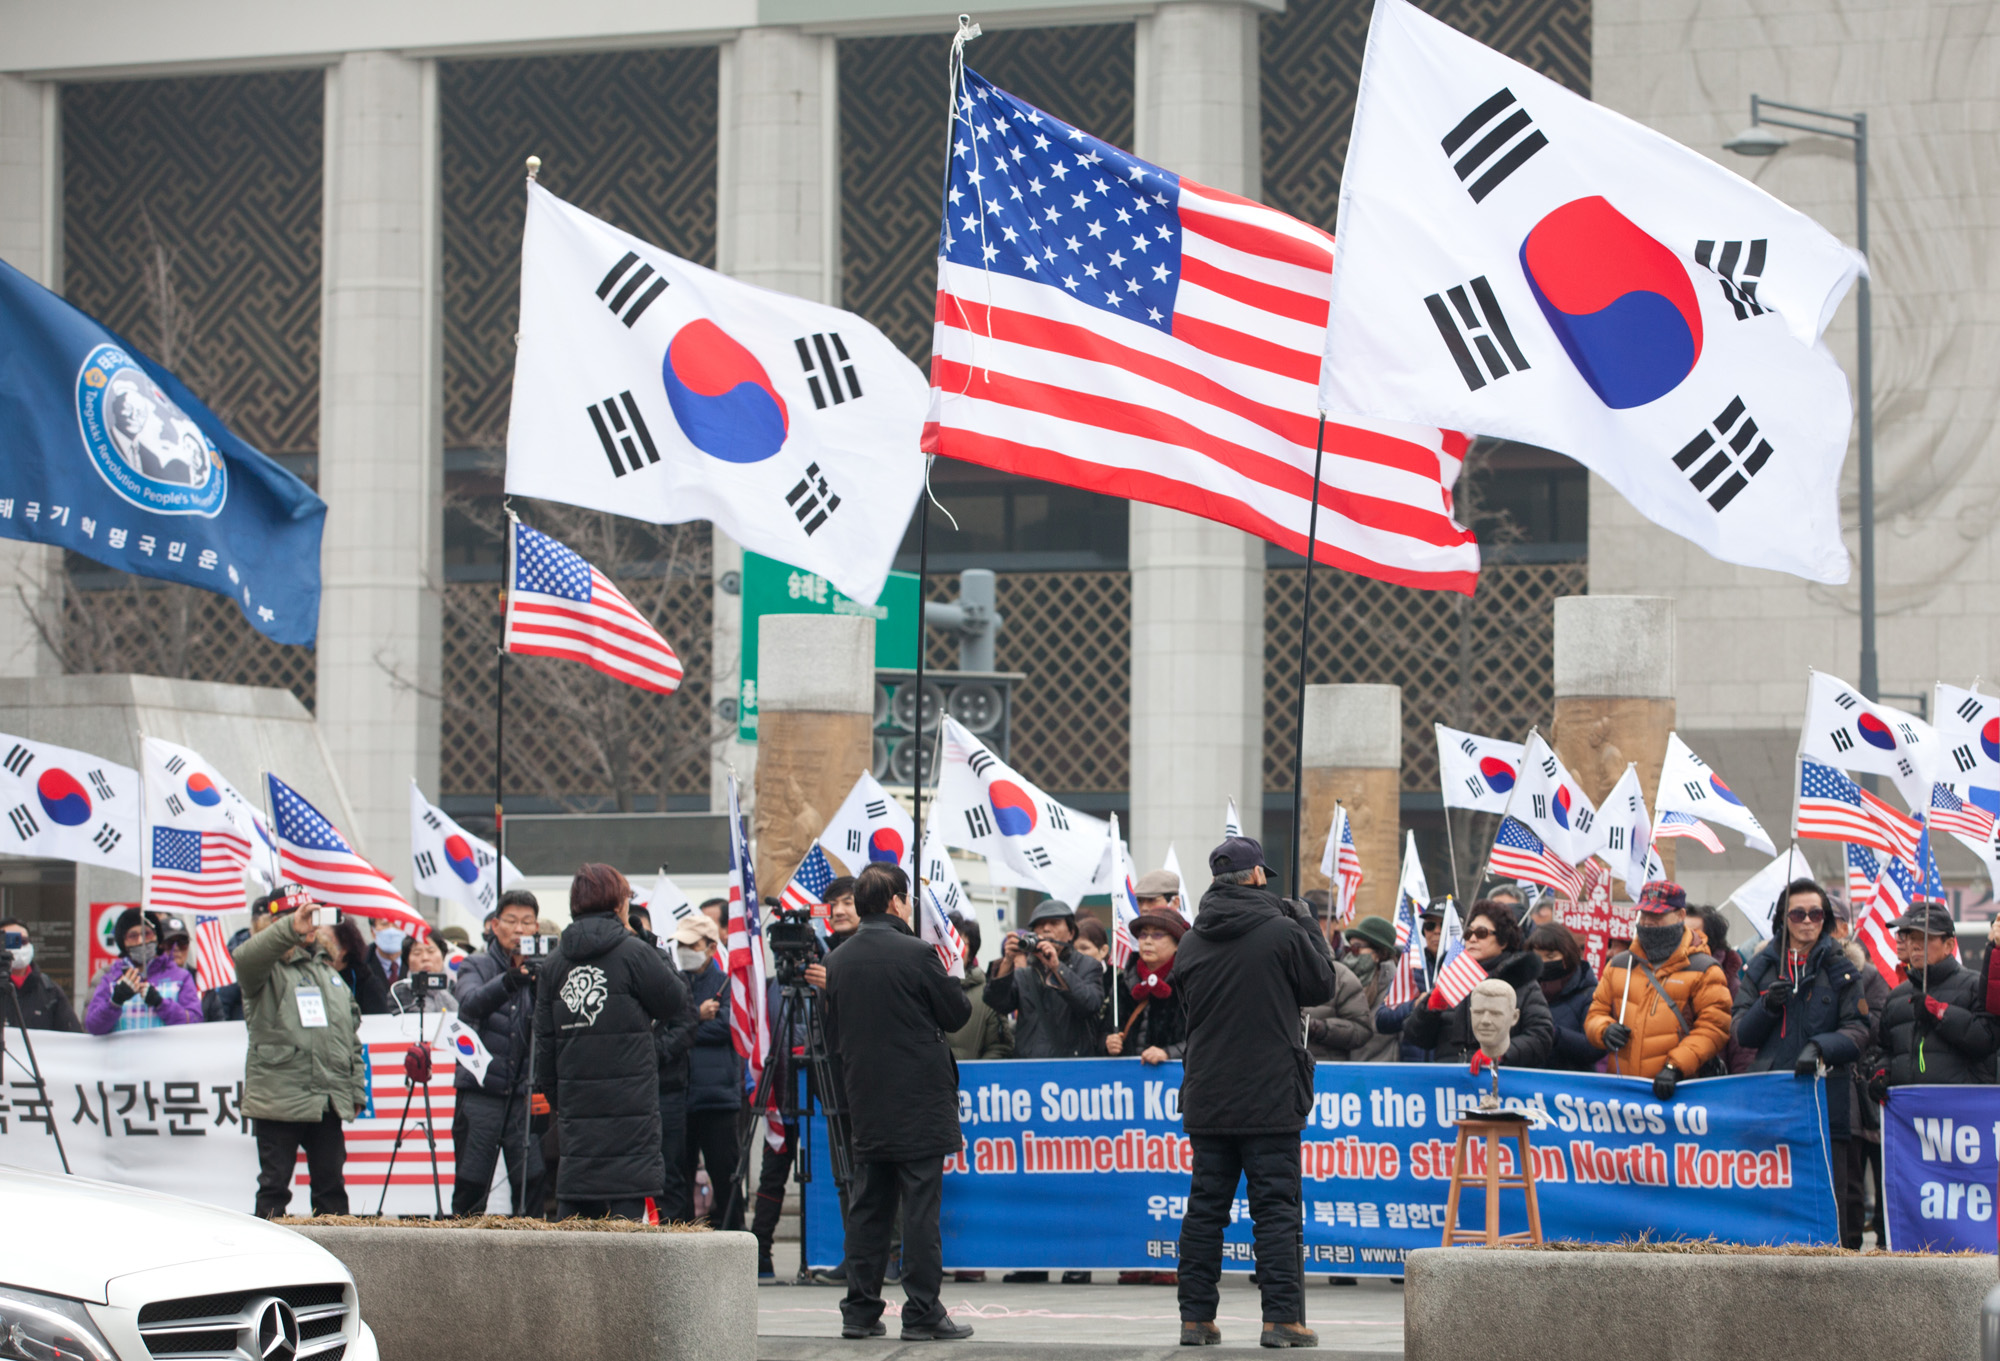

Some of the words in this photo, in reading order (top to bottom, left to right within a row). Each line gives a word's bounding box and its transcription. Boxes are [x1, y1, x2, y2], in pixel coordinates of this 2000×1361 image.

[83, 389, 102, 443] Taegukki
[97, 443, 141, 495] Revolution
[143, 487, 190, 506] People's
[787, 570, 829, 604] 숭례문
[71, 1080, 258, 1137] 시간문제
[1040, 1082, 1134, 1123] South
[1370, 1087, 1426, 1129] the
[1554, 1093, 1667, 1134] States
[1673, 1102, 1708, 1136] to
[974, 1137, 1017, 1174] an
[1570, 1140, 1669, 1187] North
[1674, 1144, 1793, 1189] Korea!
[1914, 1117, 1981, 1164] We
[1313, 1201, 1380, 1228] 북폭을
[1921, 1180, 1992, 1222] are
[1315, 1244, 1354, 1263] (국본)
